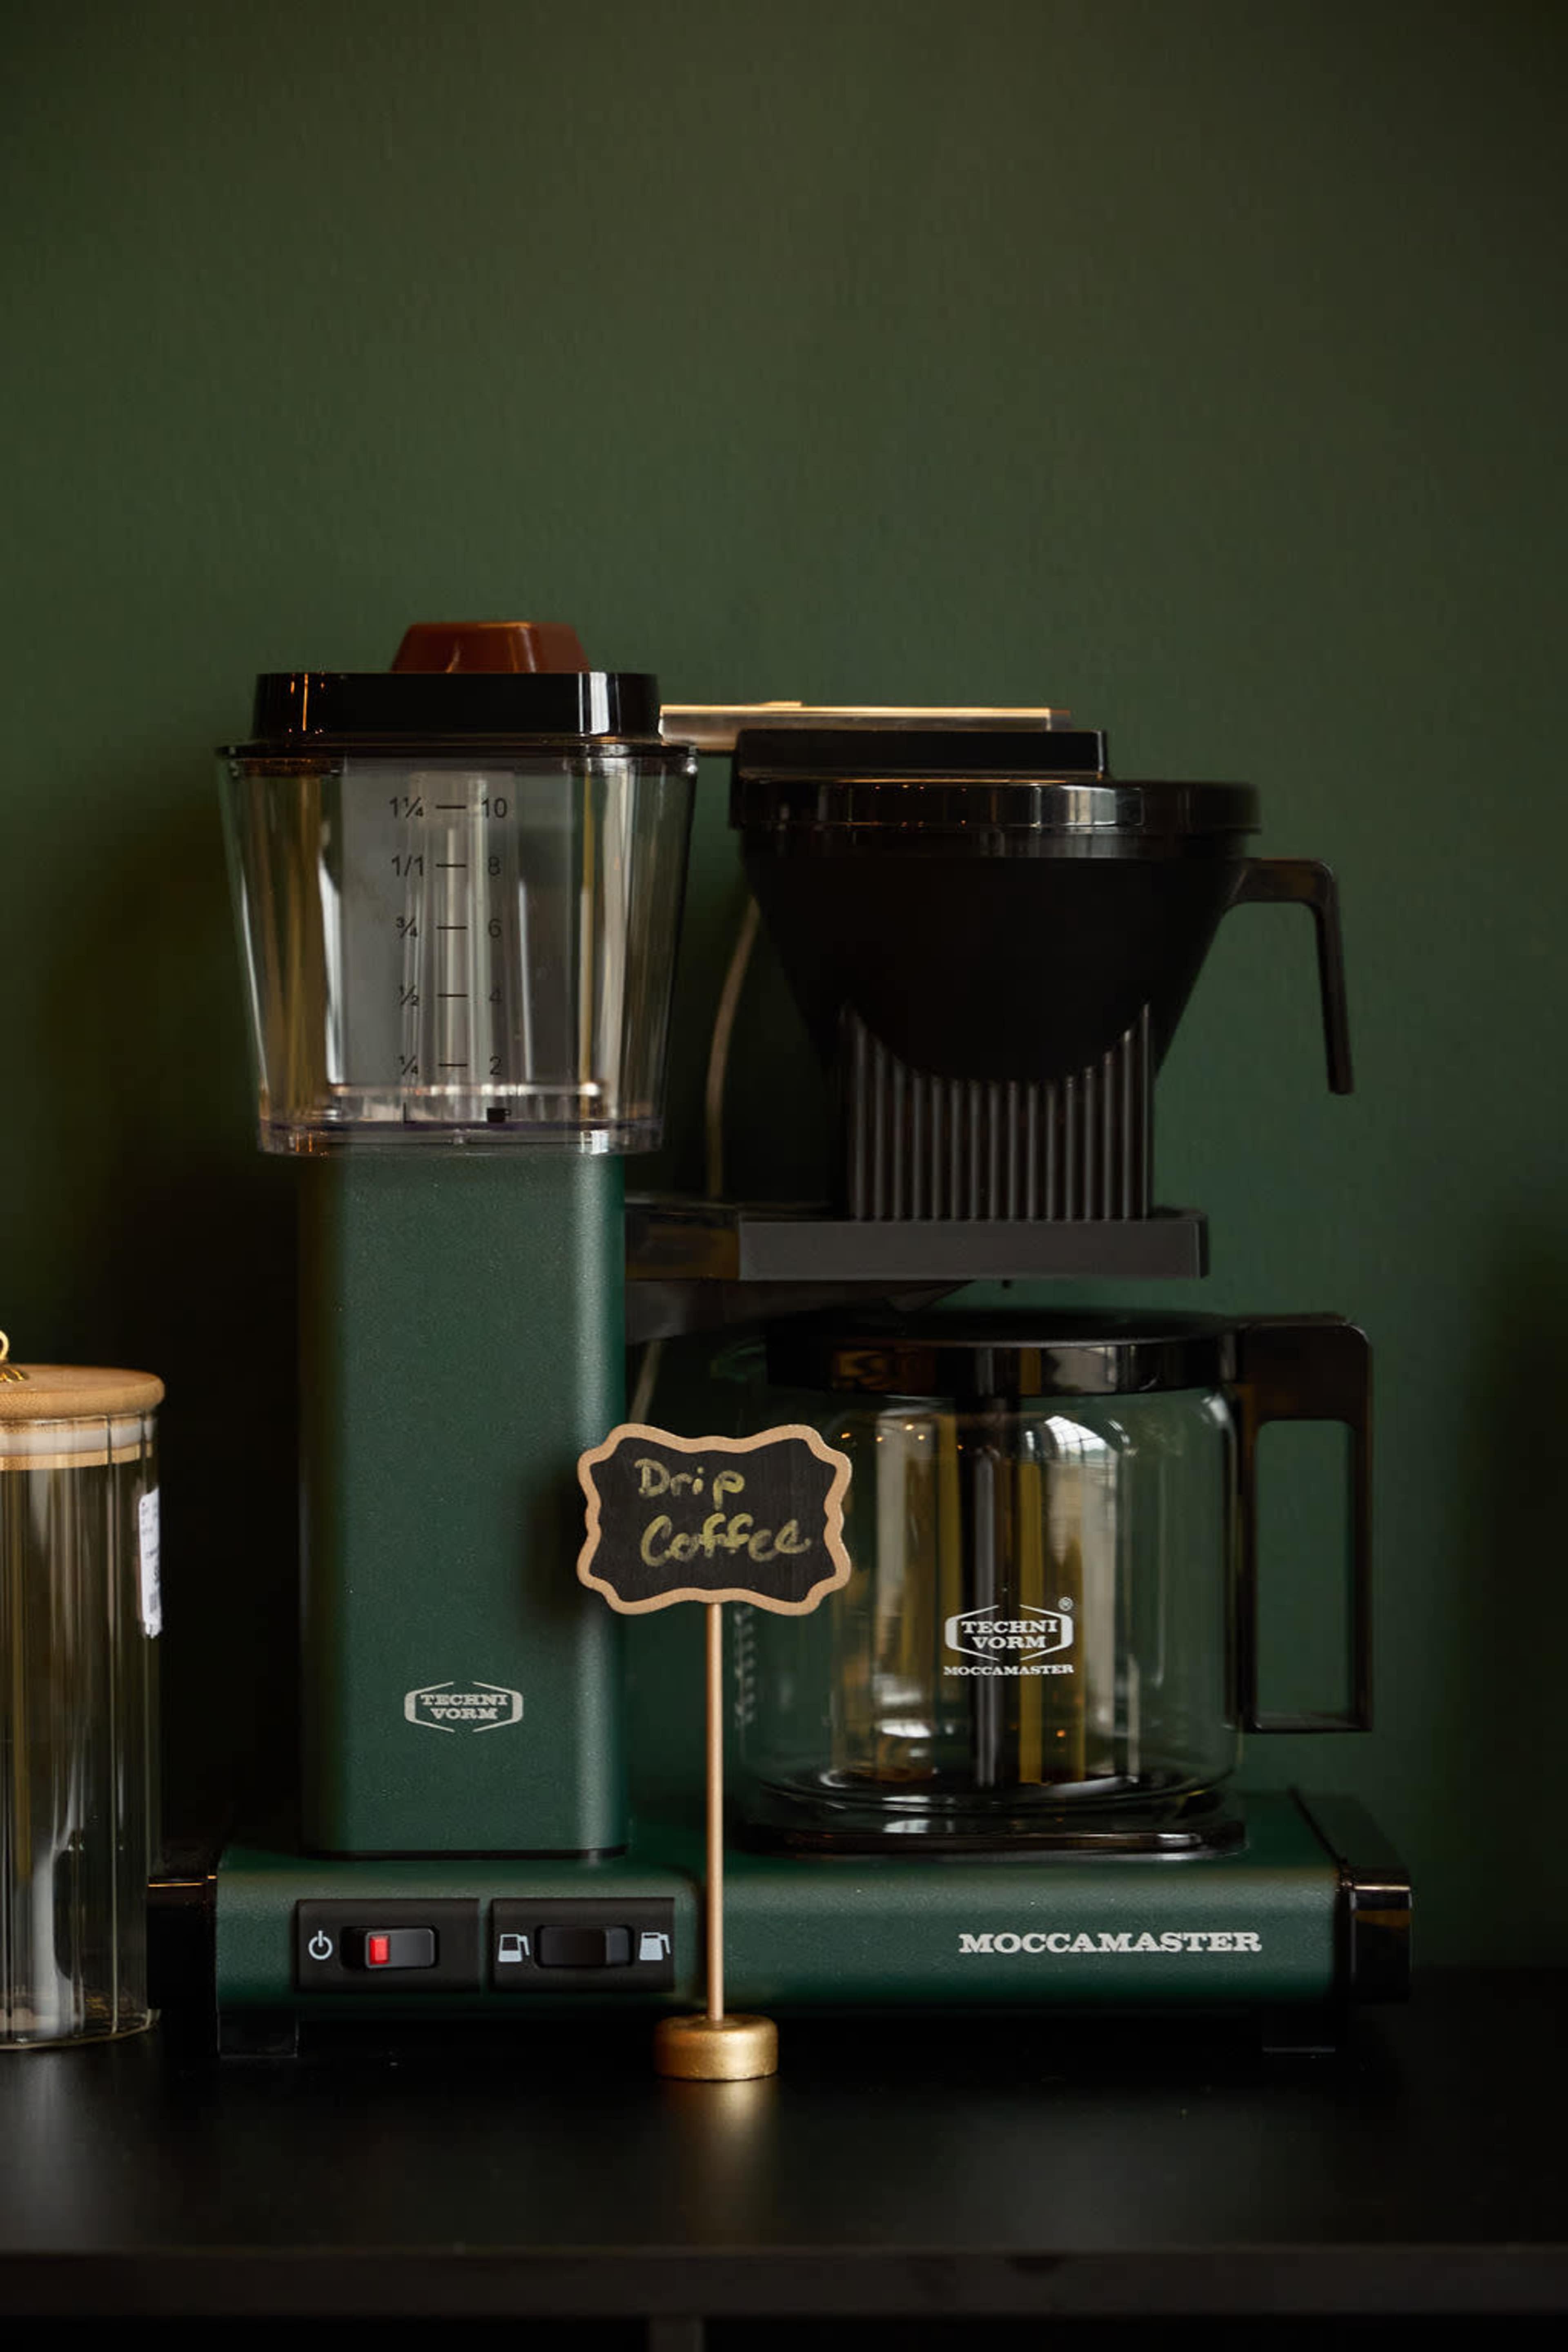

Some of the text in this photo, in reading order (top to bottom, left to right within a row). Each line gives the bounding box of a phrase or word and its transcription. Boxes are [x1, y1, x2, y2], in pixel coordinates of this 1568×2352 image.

[481, 797, 507, 818] 10
[392, 855, 501, 876] 1/1 8
[488, 918, 501, 938] 6
[489, 985, 502, 1003] 4
[490, 1056, 502, 1075] 2
[634, 1458, 745, 1510] Drip
[640, 1512, 811, 1567] Coffee
[961, 1619, 1058, 1634] TECHNI
[972, 1636, 1047, 1649] VORM
[943, 1664, 1074, 1676] MOCCAMASTER
[420, 1694, 508, 1706] TECHNI
[430, 1708, 498, 1719] VORM
[958, 1932, 1262, 1954] MOCCAMASTER
